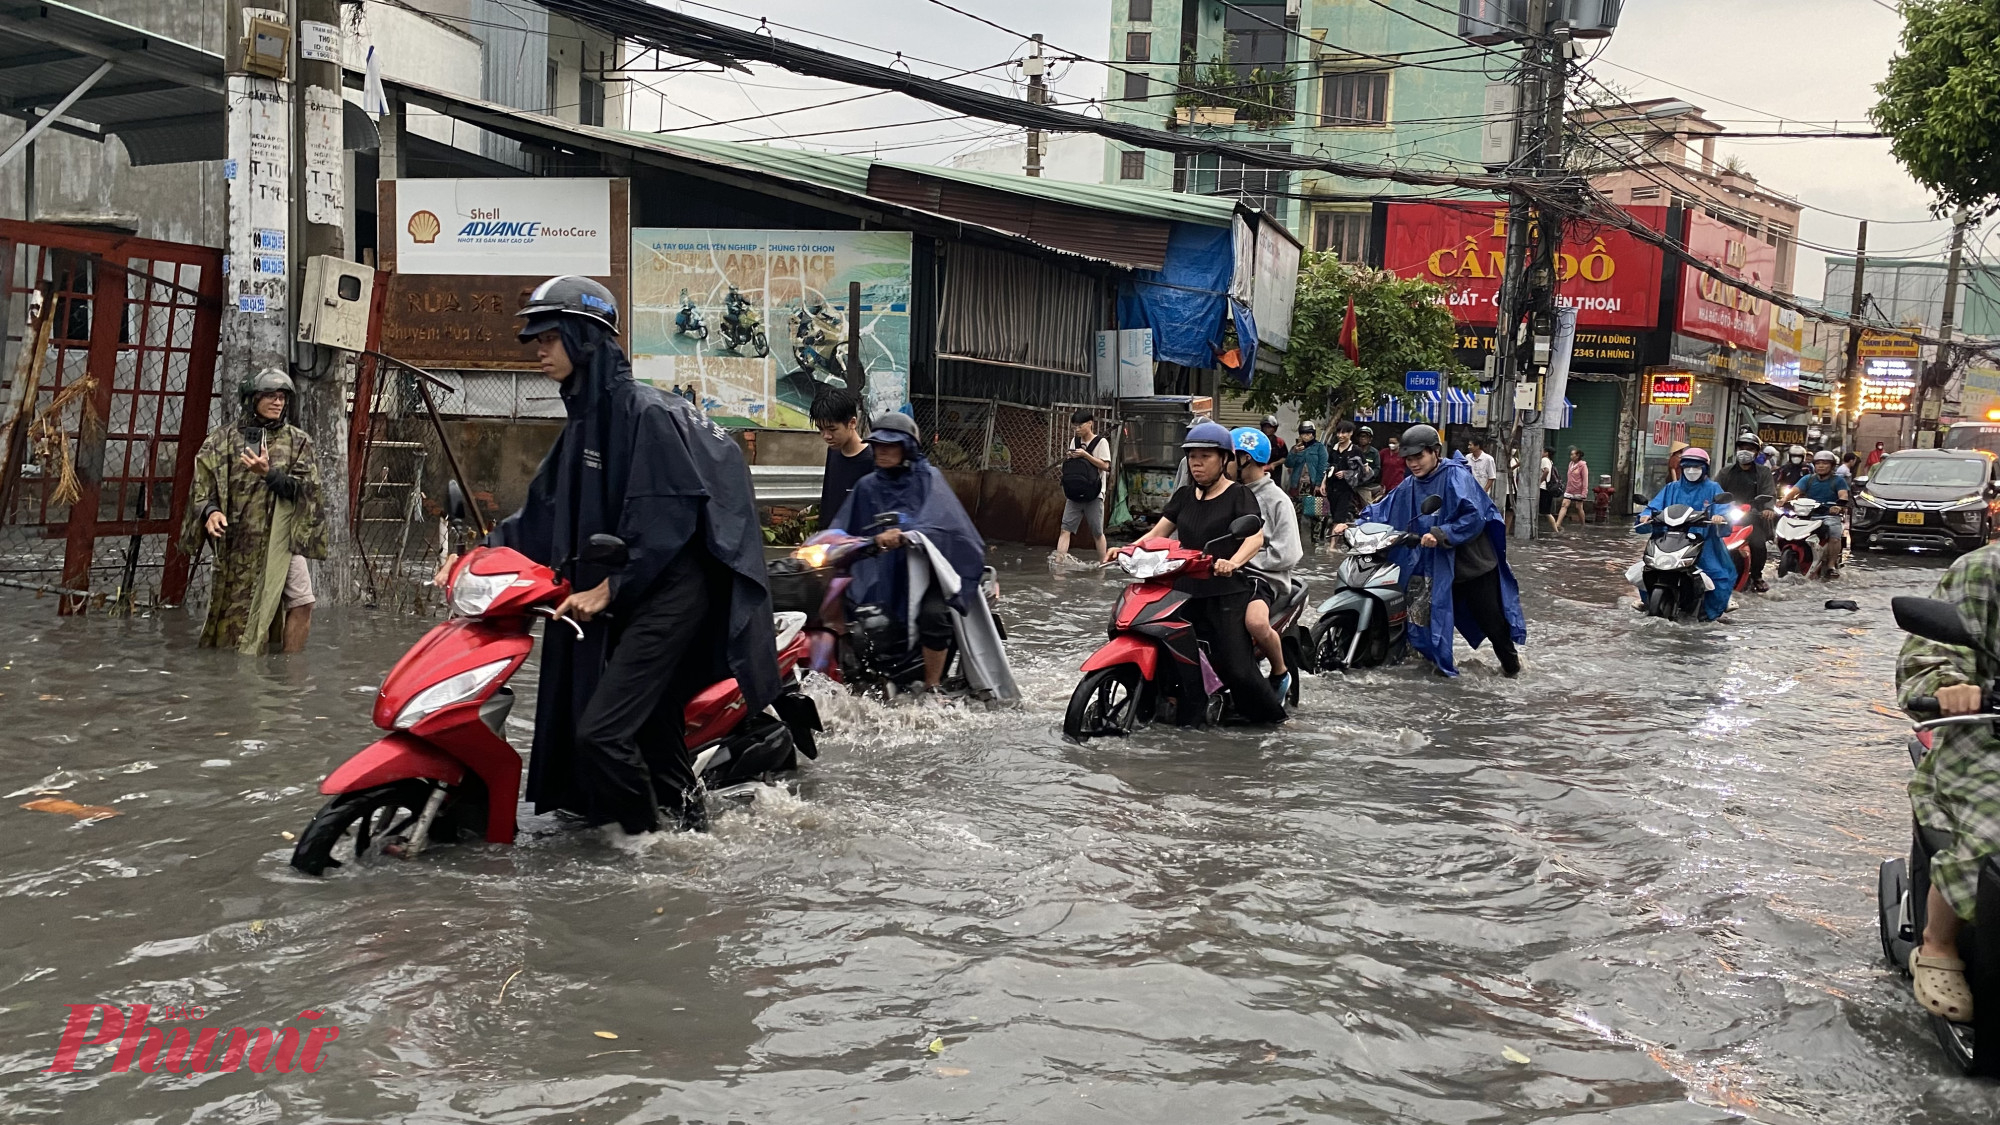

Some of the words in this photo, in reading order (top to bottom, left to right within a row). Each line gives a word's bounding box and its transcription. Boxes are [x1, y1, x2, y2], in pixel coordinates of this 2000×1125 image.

[470, 208, 500, 220] Shell
[458, 222, 541, 236] ADVANCE
[541, 227, 596, 236] MotoCare
[1553, 237, 1616, 282] ĐỒ
[1450, 288, 1478, 306] ĐẤT
[1576, 297, 1620, 313] THOẠI
[1463, 336, 1478, 348] XE
[1576, 334, 1596, 343] 7777
[1574, 348, 1594, 358] 2345
[1410, 374, 1424, 385] HẺM
